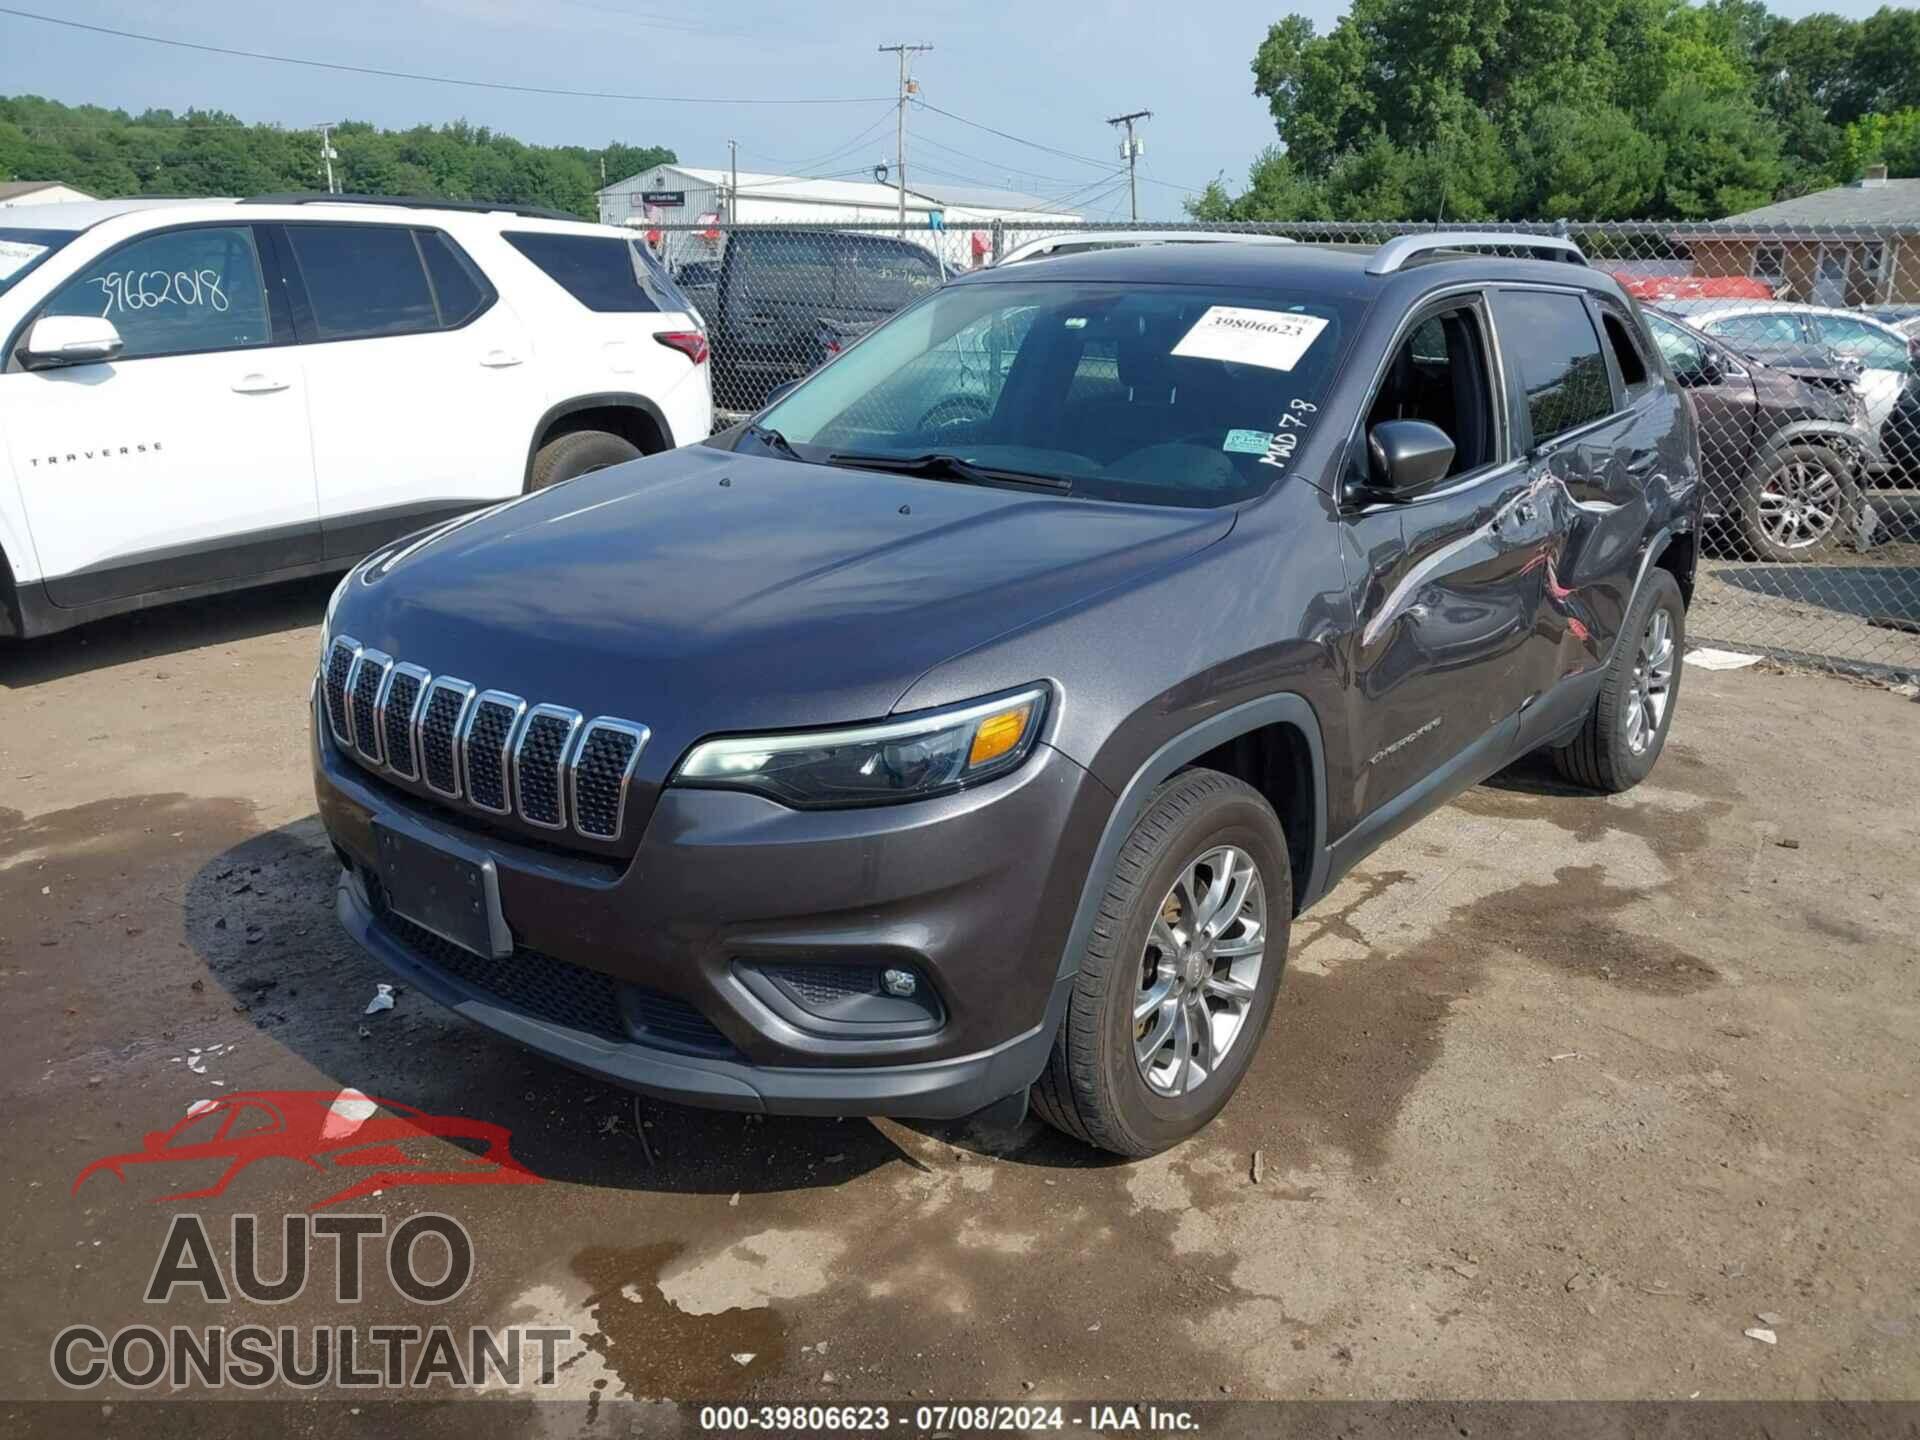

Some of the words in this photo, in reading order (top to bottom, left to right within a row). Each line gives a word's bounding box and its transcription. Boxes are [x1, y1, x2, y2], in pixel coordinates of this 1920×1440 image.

[86, 269, 229, 318] 39662018
[1208, 316, 1304, 337] 39806623
[30, 442, 164, 467] TRAVERSE
[1258, 433, 1298, 468] MAD
